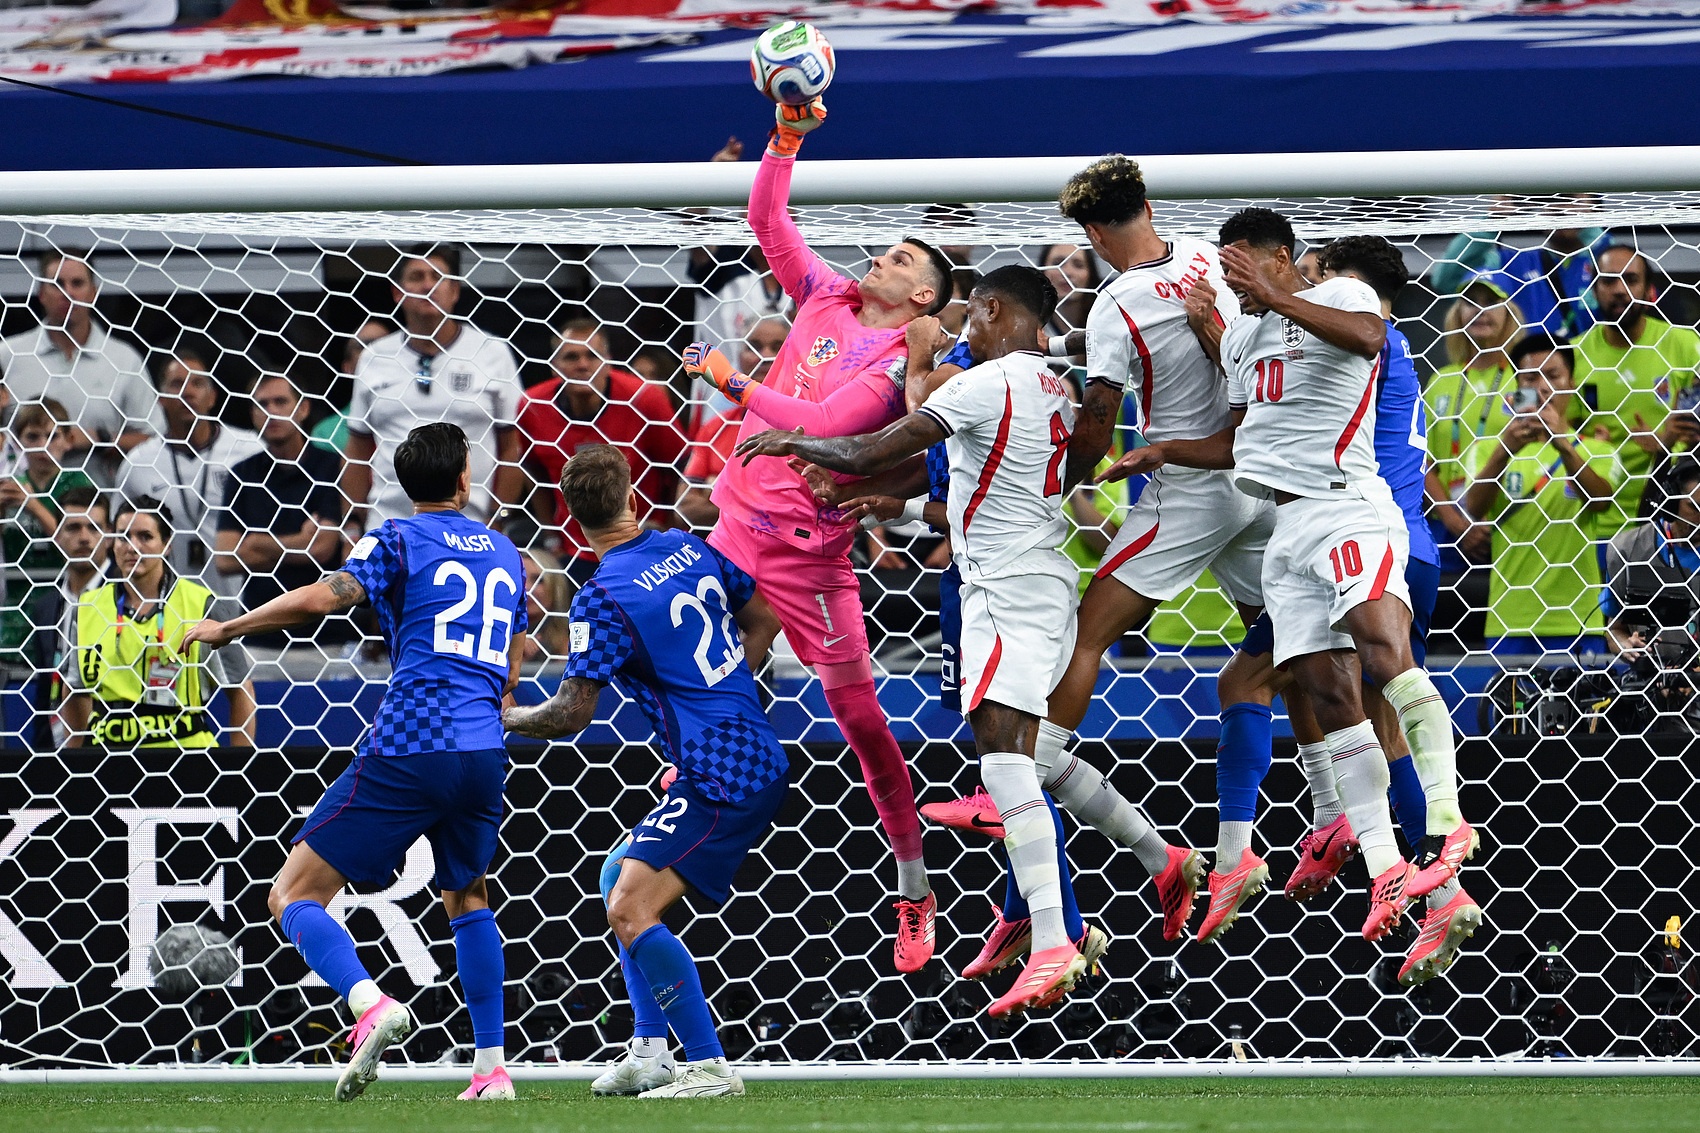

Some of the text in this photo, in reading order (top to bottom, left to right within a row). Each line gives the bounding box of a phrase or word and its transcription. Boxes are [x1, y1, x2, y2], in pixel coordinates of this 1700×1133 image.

[1254, 359, 1284, 403] 10
[1043, 410, 1072, 498] 2
[442, 531, 496, 552] MUSA
[1329, 540, 1364, 583] 10
[432, 560, 517, 668] 26
[670, 575, 746, 688] 22
[815, 593, 834, 632] 1
[641, 793, 689, 834] 22
